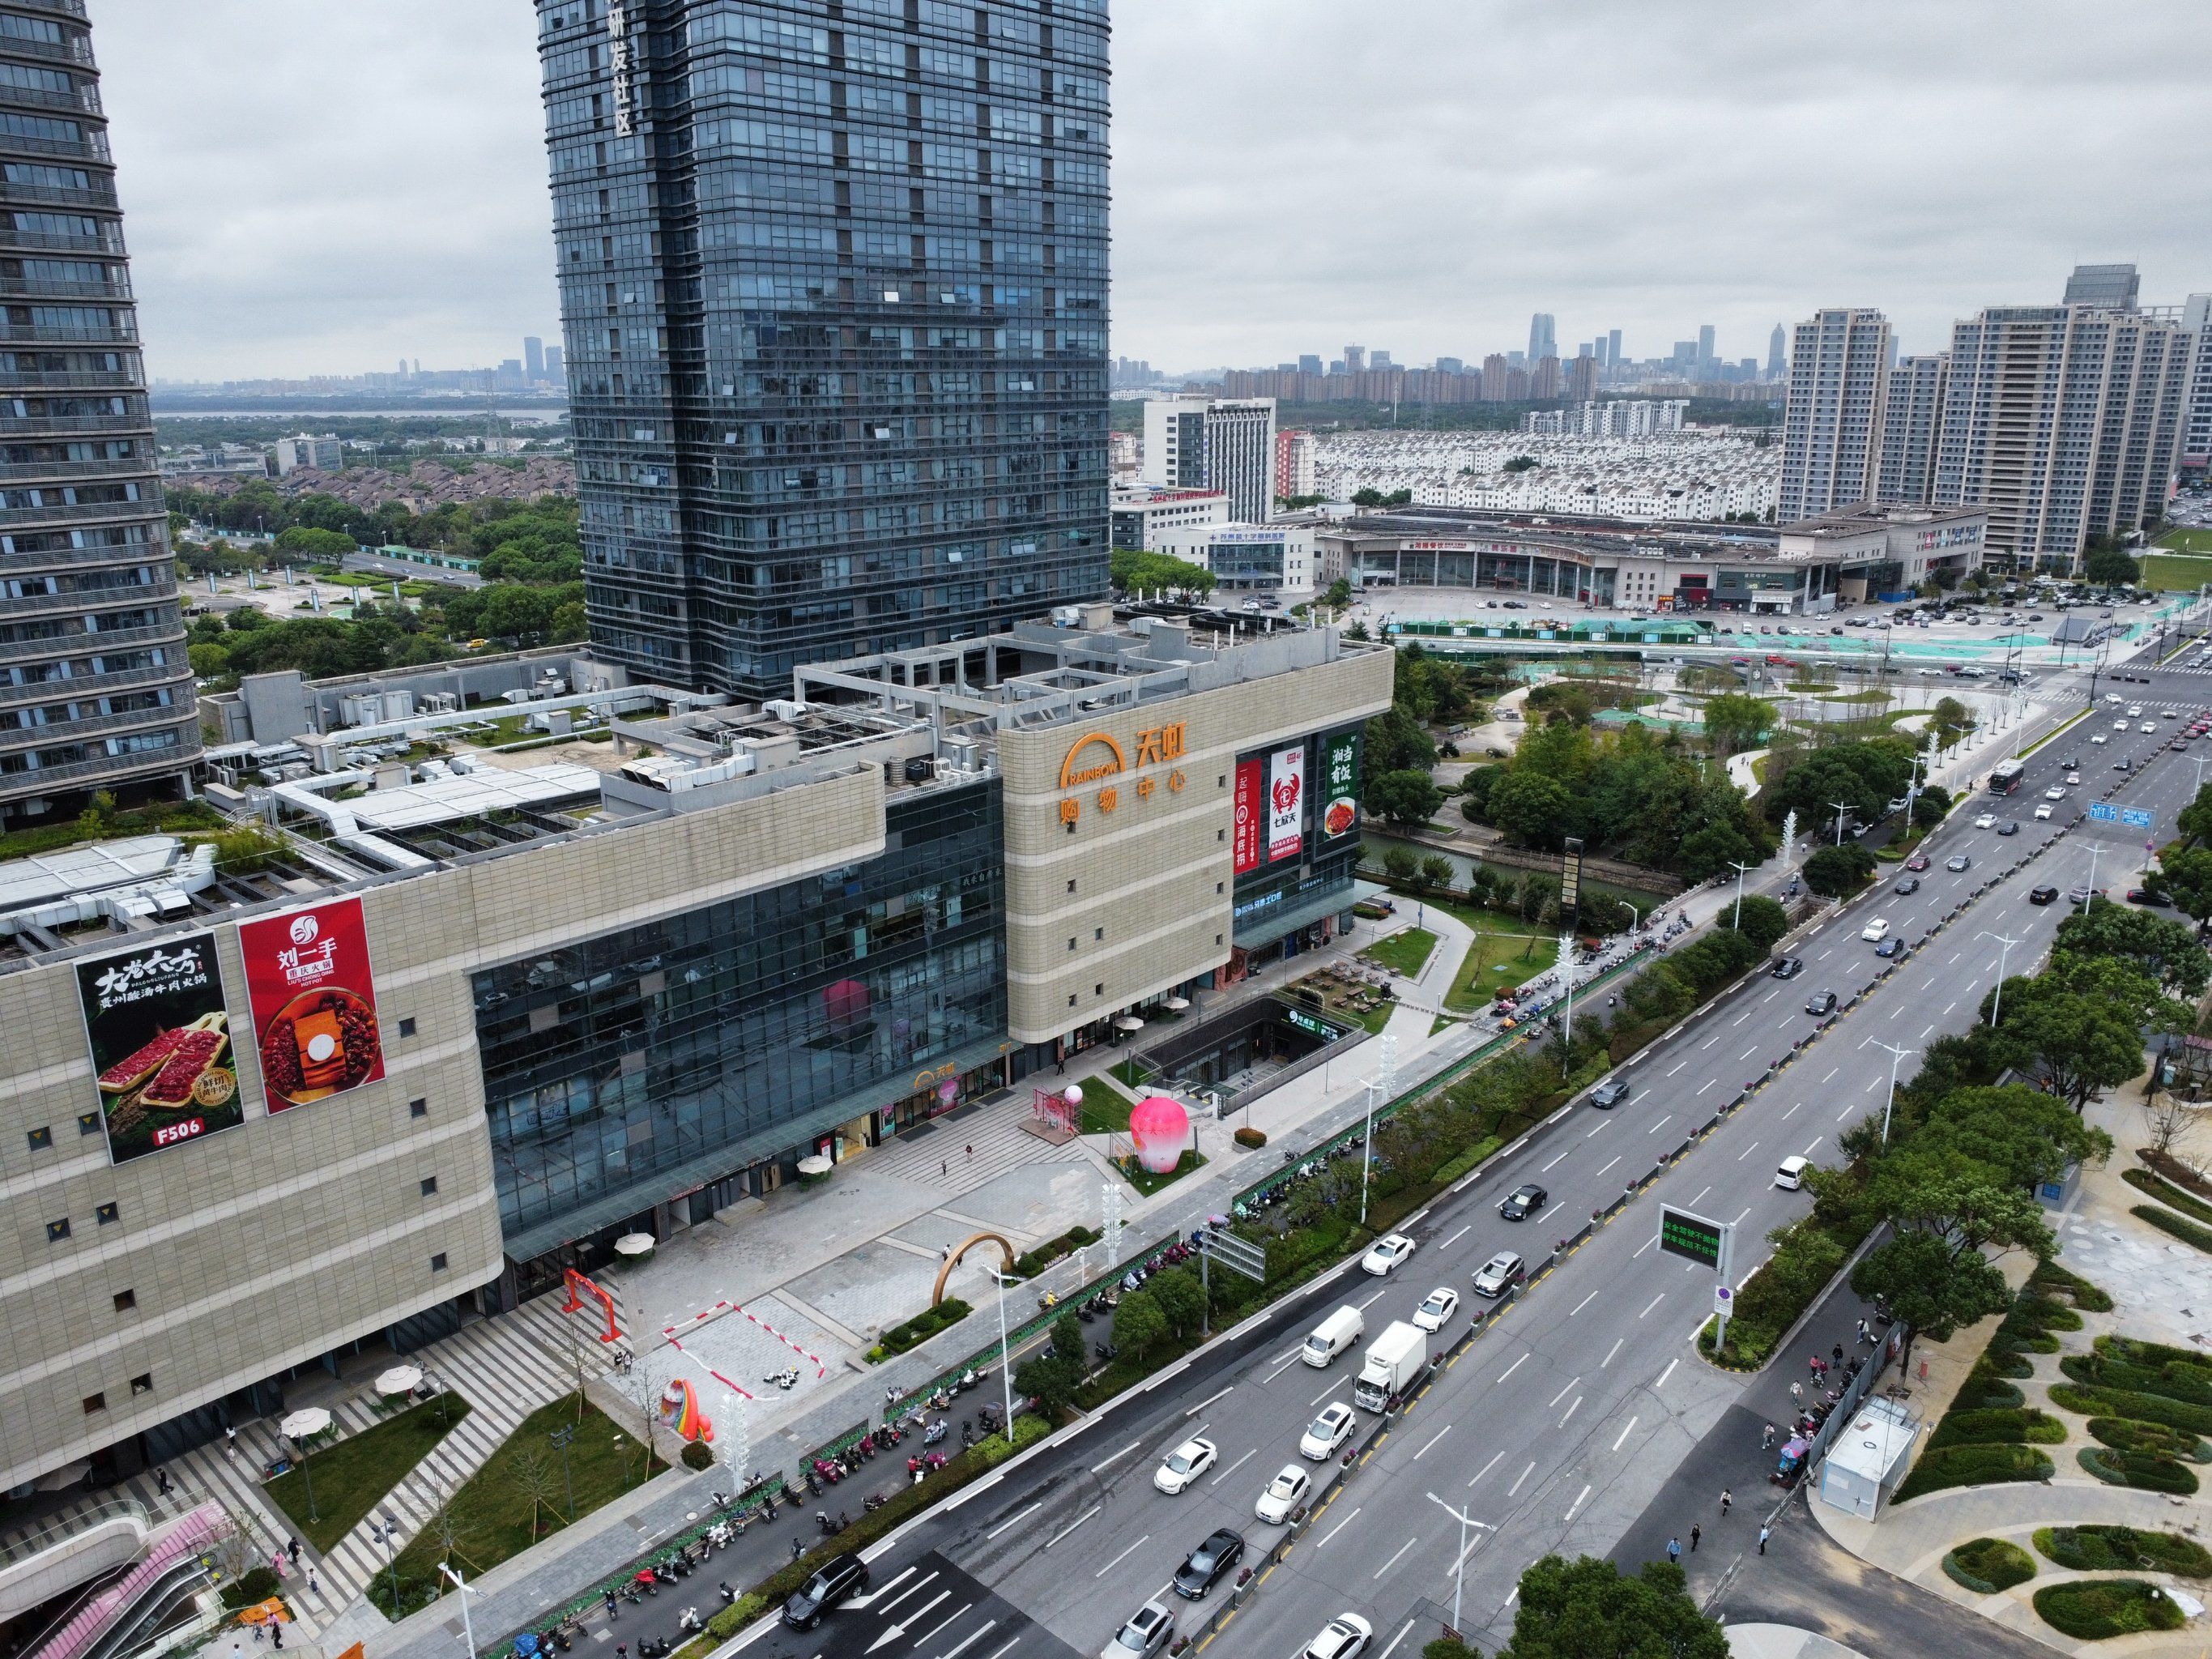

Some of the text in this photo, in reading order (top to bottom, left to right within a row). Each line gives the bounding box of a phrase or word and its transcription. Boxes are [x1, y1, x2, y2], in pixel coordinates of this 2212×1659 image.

[1136, 720, 1188, 767] 天虹
[1332, 745, 1353, 765] 湘当
[1070, 761, 1119, 786] RAINBOW
[1331, 764, 1352, 784] 有饭
[1061, 769, 1186, 825] 购物中心
[1273, 812, 1296, 828] 七欣天
[1236, 825, 1247, 868] 海底捞
[277, 937, 337, 970] 刘一手
[95, 949, 199, 996] 大龙六方
[289, 961, 330, 978] 重庆火锅
[302, 973, 321, 983] CHONG
[100, 973, 207, 1009] 贵州酸汤牛肉火锅
[312, 977, 322, 985] POT
[202, 1084, 228, 1097] 黄牛肉
[203, 1075, 224, 1088] 鲜切
[157, 1120, 200, 1144] F506
